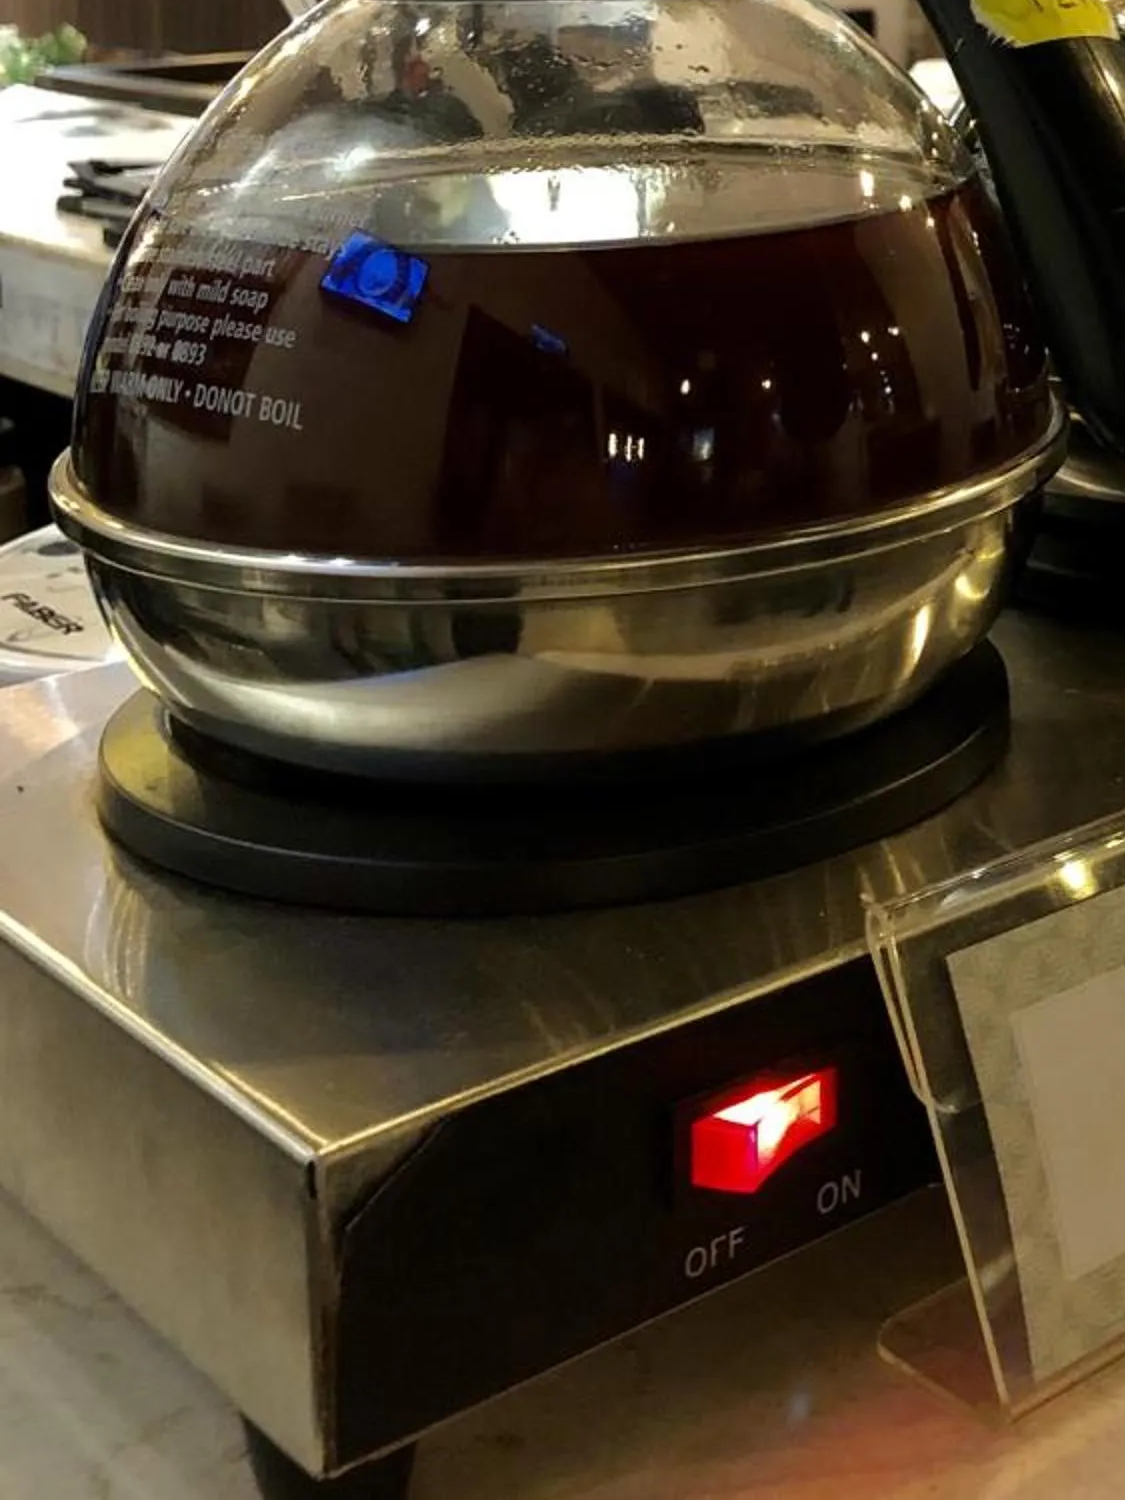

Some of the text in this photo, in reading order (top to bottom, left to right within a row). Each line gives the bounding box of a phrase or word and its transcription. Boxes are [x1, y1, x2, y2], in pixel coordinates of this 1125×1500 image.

[230, 286, 268, 315] soap
[156, 308, 210, 335] purpose
[209, 313, 263, 341] please
[264, 325, 298, 349] use
[193, 383, 257, 418] DONOT
[258, 396, 304, 430] BOIL
[684, 1169, 862, 1278] OFF ON
